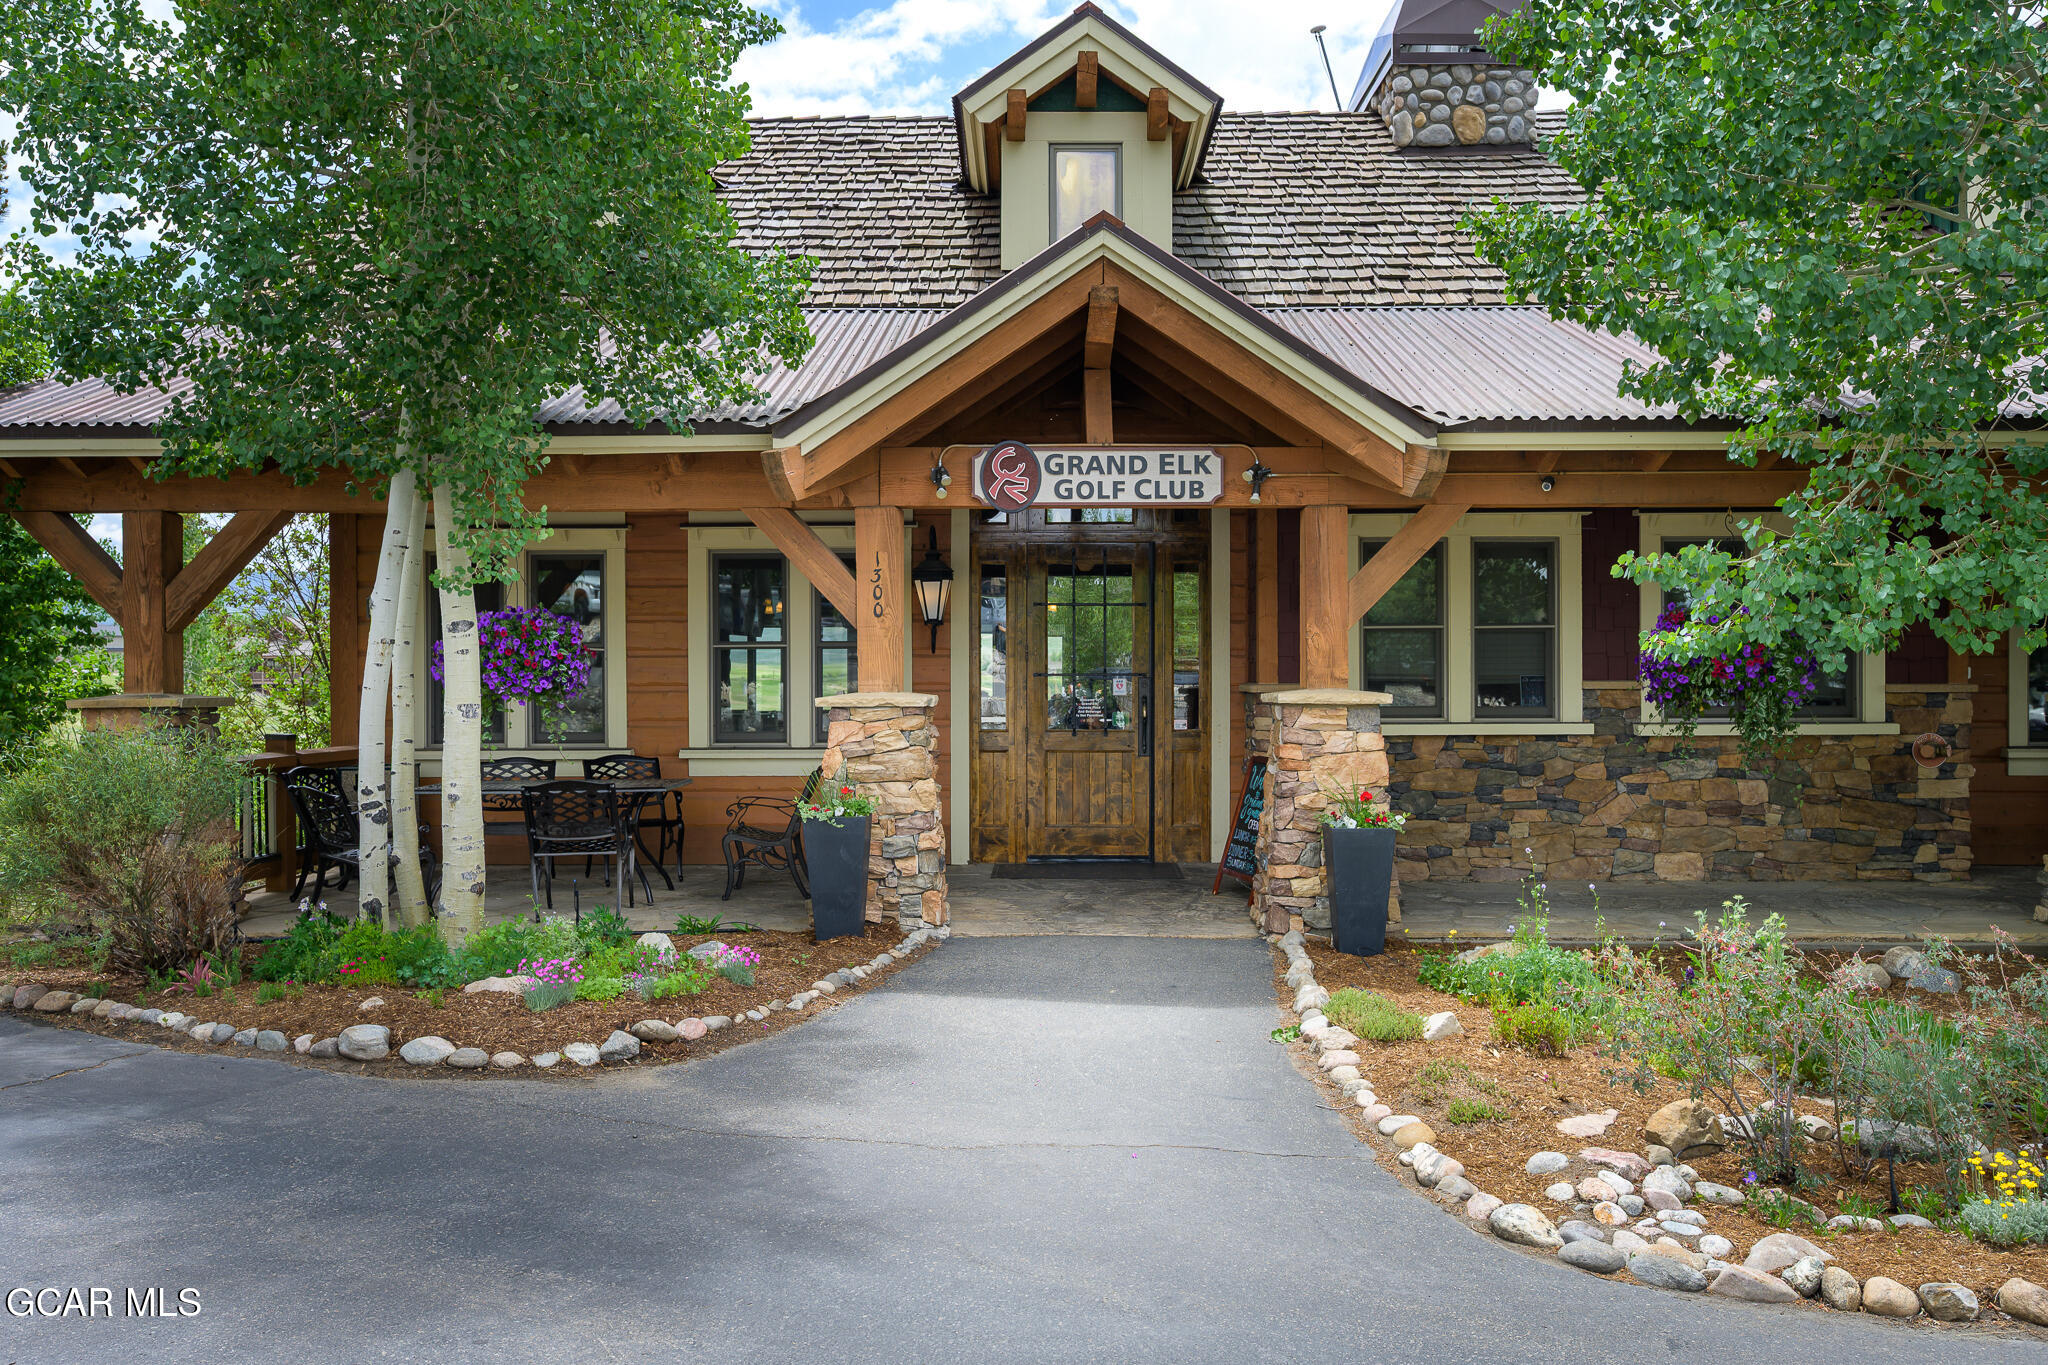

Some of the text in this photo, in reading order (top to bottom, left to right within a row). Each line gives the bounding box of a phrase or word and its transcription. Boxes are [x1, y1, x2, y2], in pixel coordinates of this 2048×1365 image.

[1044, 453, 1213, 476] GRAND ELK
[1053, 478, 1205, 500] GOLF CLUB
[870, 551, 883, 618] 1300
